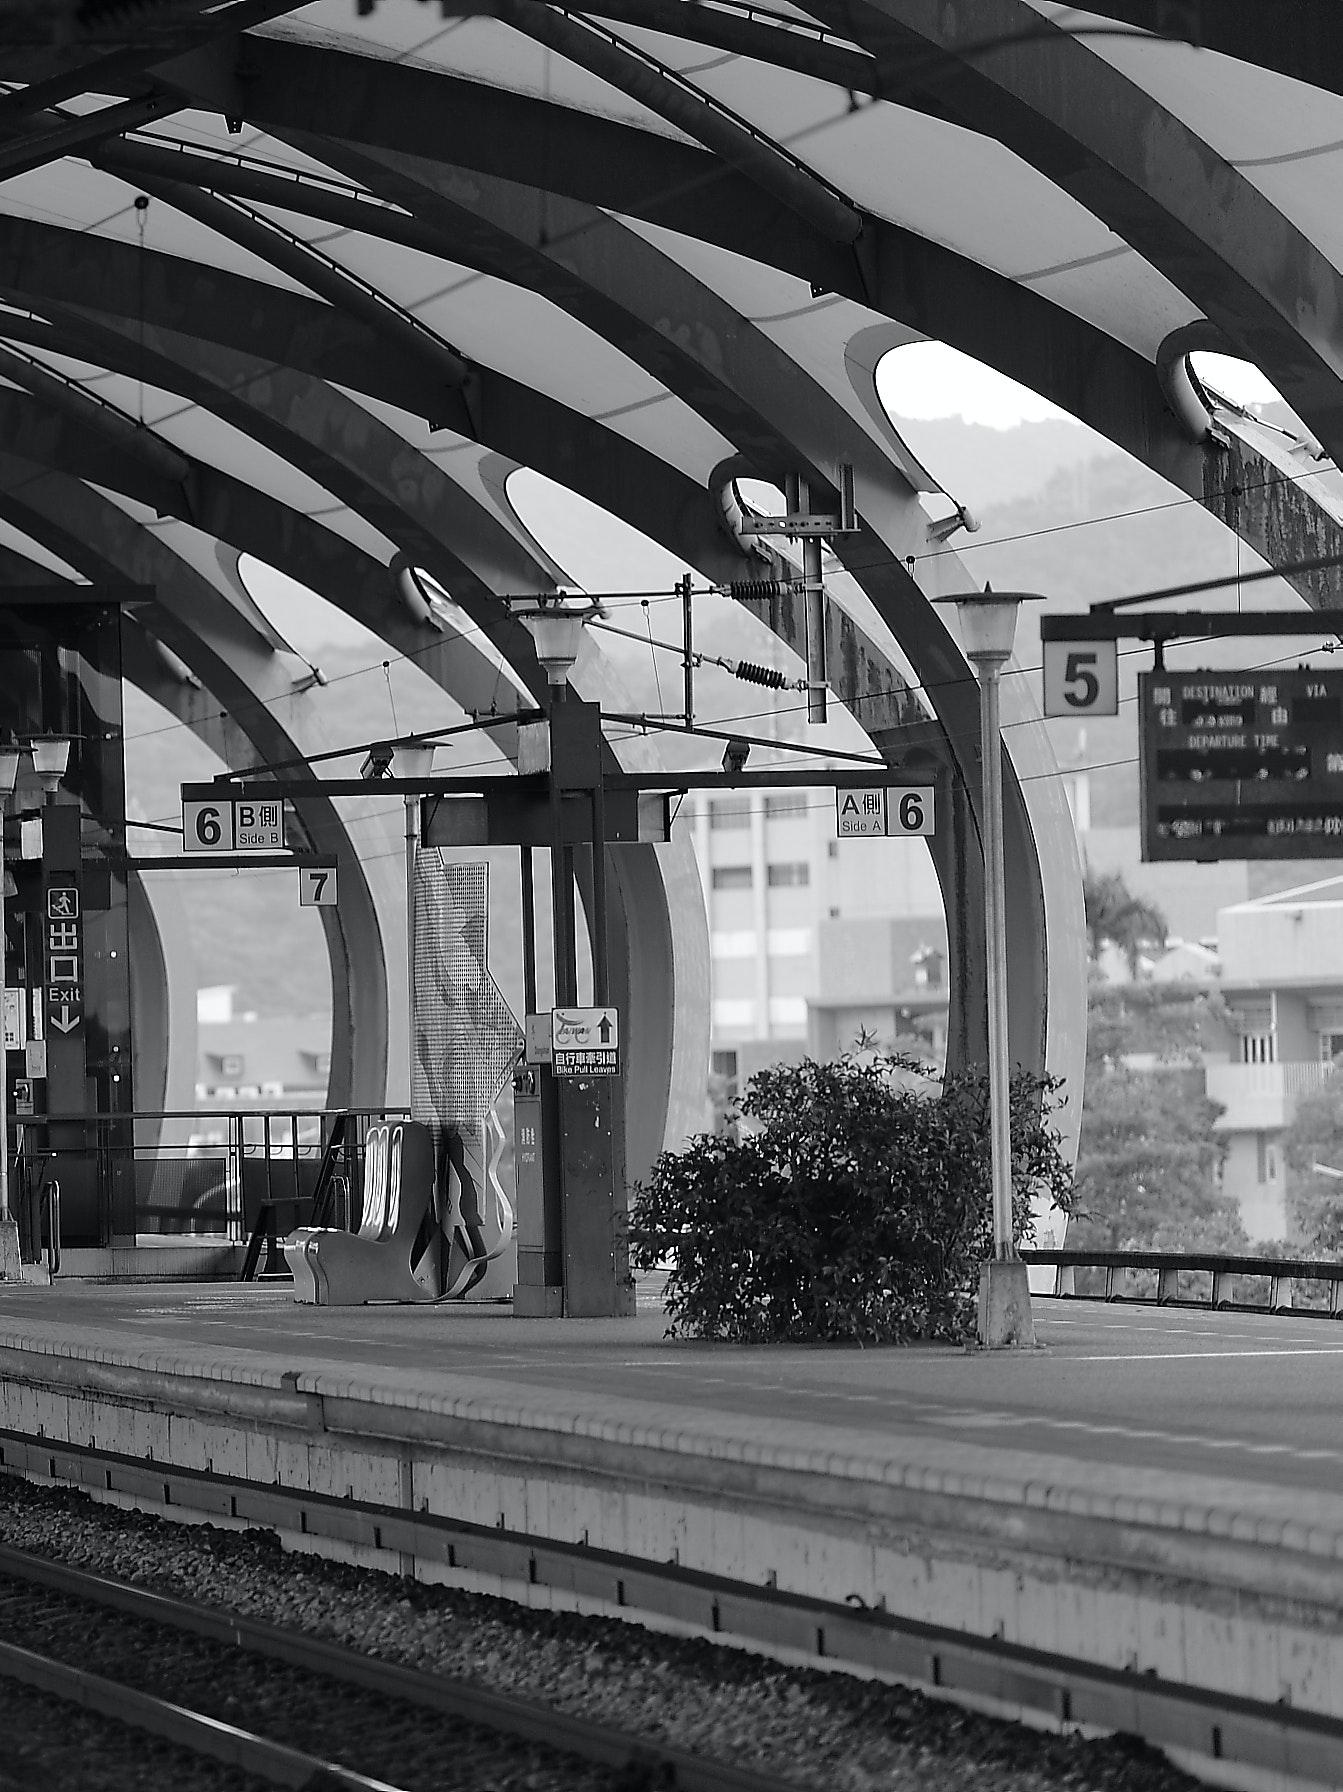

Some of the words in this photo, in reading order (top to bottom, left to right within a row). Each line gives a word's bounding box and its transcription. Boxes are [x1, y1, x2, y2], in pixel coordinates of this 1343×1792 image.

[1064, 653, 1100, 707] 5
[1182, 685, 1255, 698] DESTINATION
[1306, 684, 1327, 697] VIA
[1188, 735, 1247, 748] DEPARTURE
[1254, 734, 1280, 747] TIME
[841, 793, 881, 815] A側
[899, 793, 924, 831] 6
[239, 805, 278, 827] B側
[195, 807, 222, 845] 6
[842, 820, 867, 832] Side
[872, 820, 882, 831] A
[239, 833, 265, 844] Side
[270, 833, 279, 843] B
[309, 873, 329, 901] 7
[49, 923, 78, 983] 出口
[49, 988, 81, 1001] Exit
[556, 1066, 573, 1074] Bike
[574, 1065, 588, 1074] Pull
